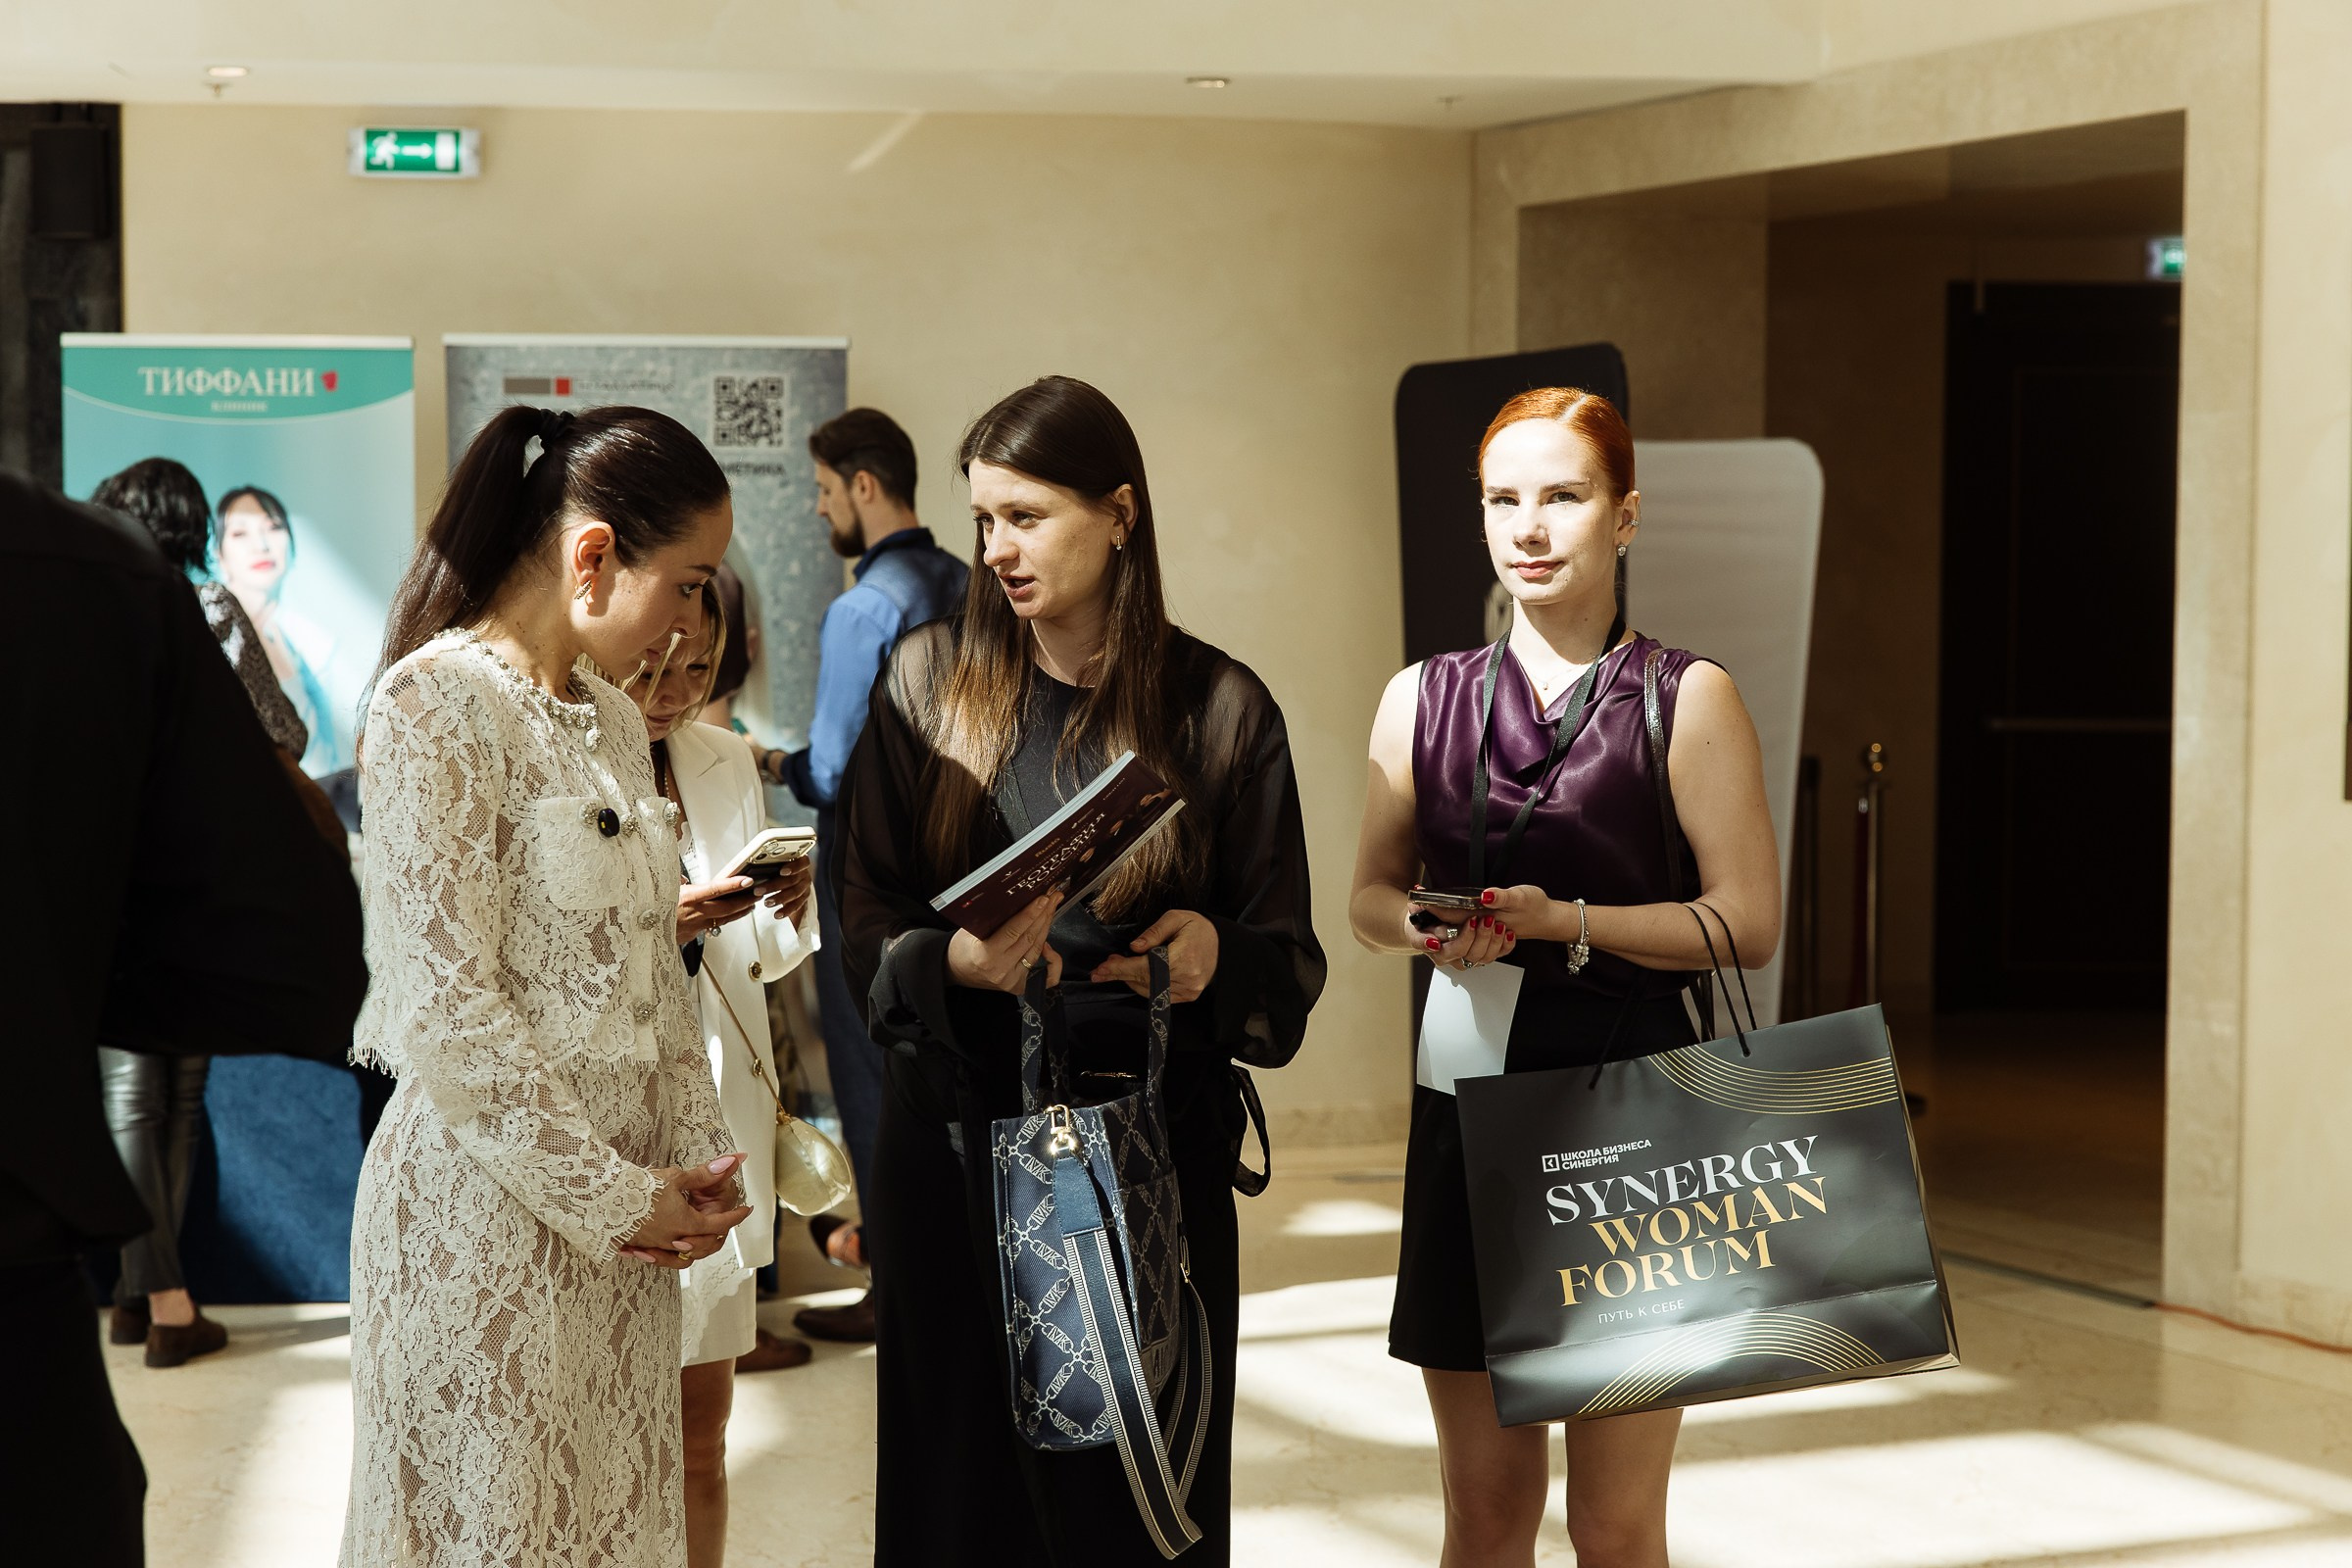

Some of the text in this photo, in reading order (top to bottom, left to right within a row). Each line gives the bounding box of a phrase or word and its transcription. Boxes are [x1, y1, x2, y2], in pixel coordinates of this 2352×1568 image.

[137, 367, 315, 397] ТИФФАНИ
[1005, 812, 1106, 896] ГЕОГРАФИЯ
[1026, 828, 1096, 889] РОССИИ
[1545, 1135, 1819, 1226] SYNERGY
[1561, 1139, 1651, 1161] ШКОЛА БИЗНЕСА
[1562, 1154, 1619, 1170] СИНЕРГИЯ
[1589, 1177, 1828, 1256] WOMAN
[1556, 1229, 1776, 1306] FORUM
[1597, 1299, 1685, 1324] ПУТЬ К СЕБЕ
